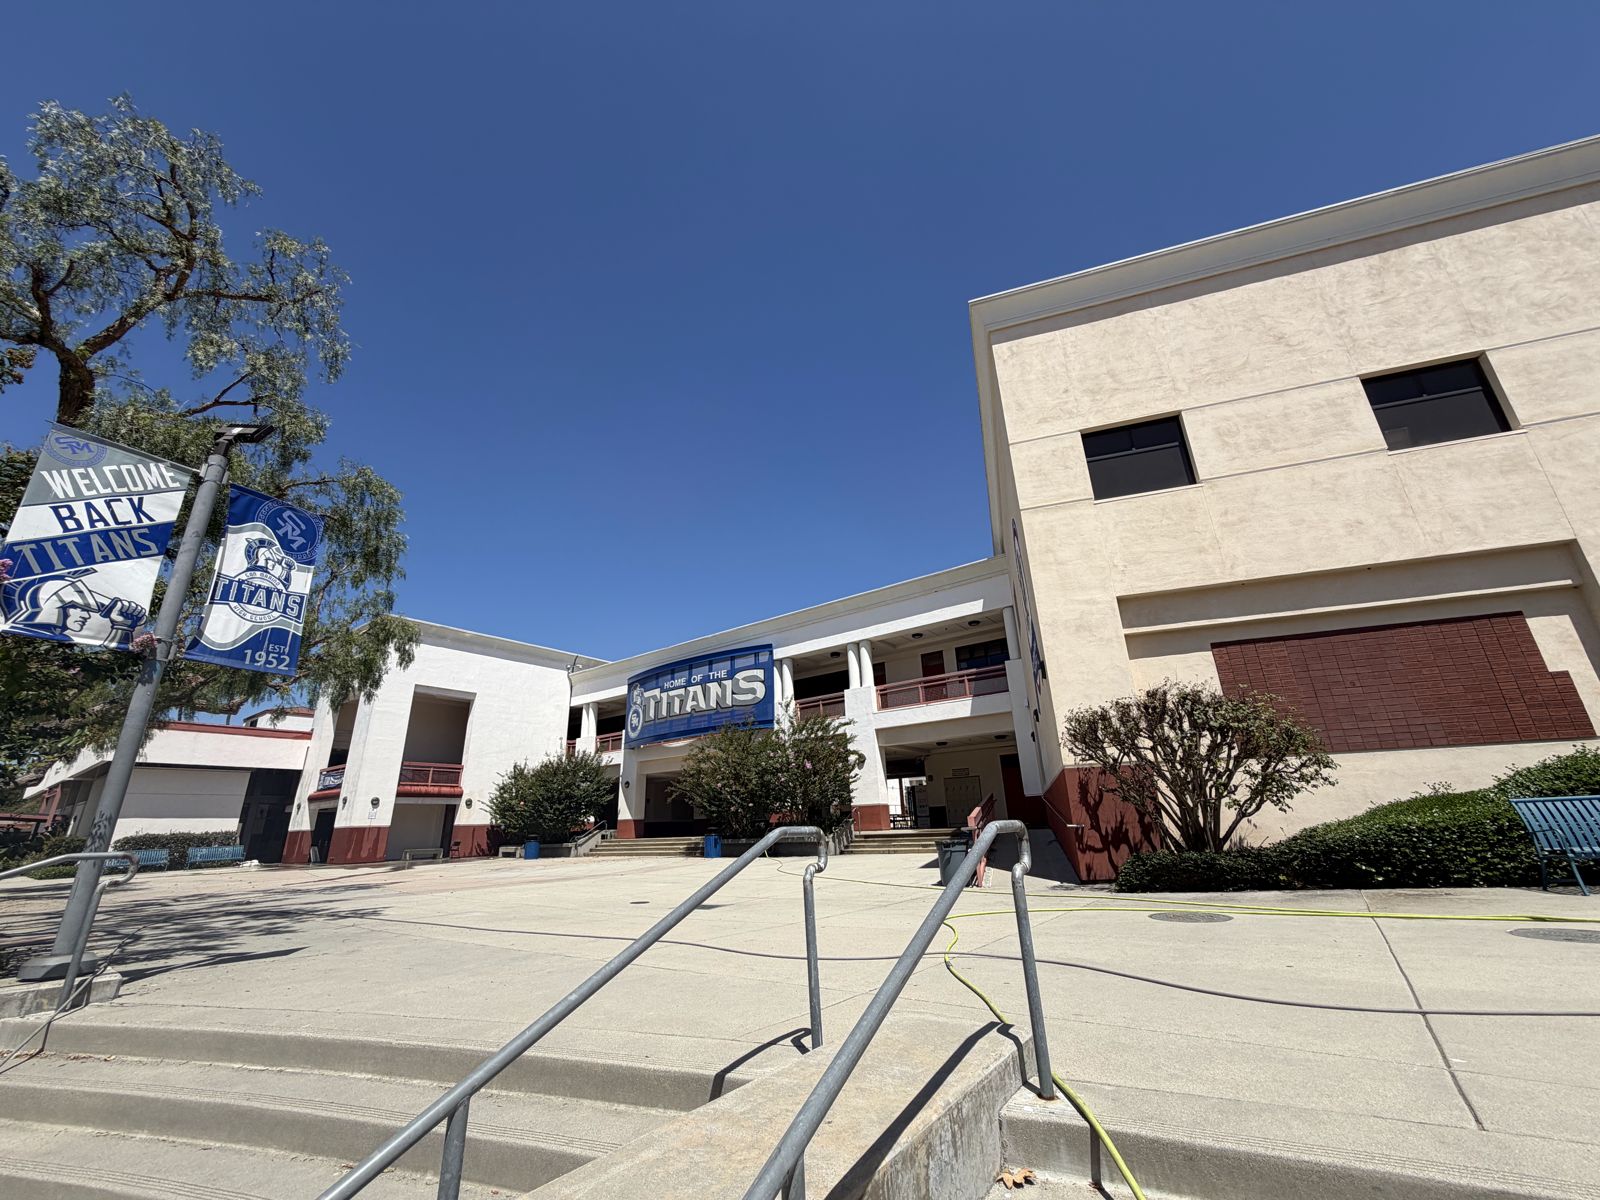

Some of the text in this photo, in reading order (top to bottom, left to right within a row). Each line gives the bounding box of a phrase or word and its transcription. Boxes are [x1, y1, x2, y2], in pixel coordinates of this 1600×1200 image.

[40, 463, 181, 499] WELCOME
[48, 497, 156, 533] BACK
[13, 528, 159, 574] TITANS
[214, 578, 301, 617] TITANS
[244, 649, 291, 671] 1952
[644, 669, 766, 722] TITANS
[664, 670, 728, 689] HOME OF THE
